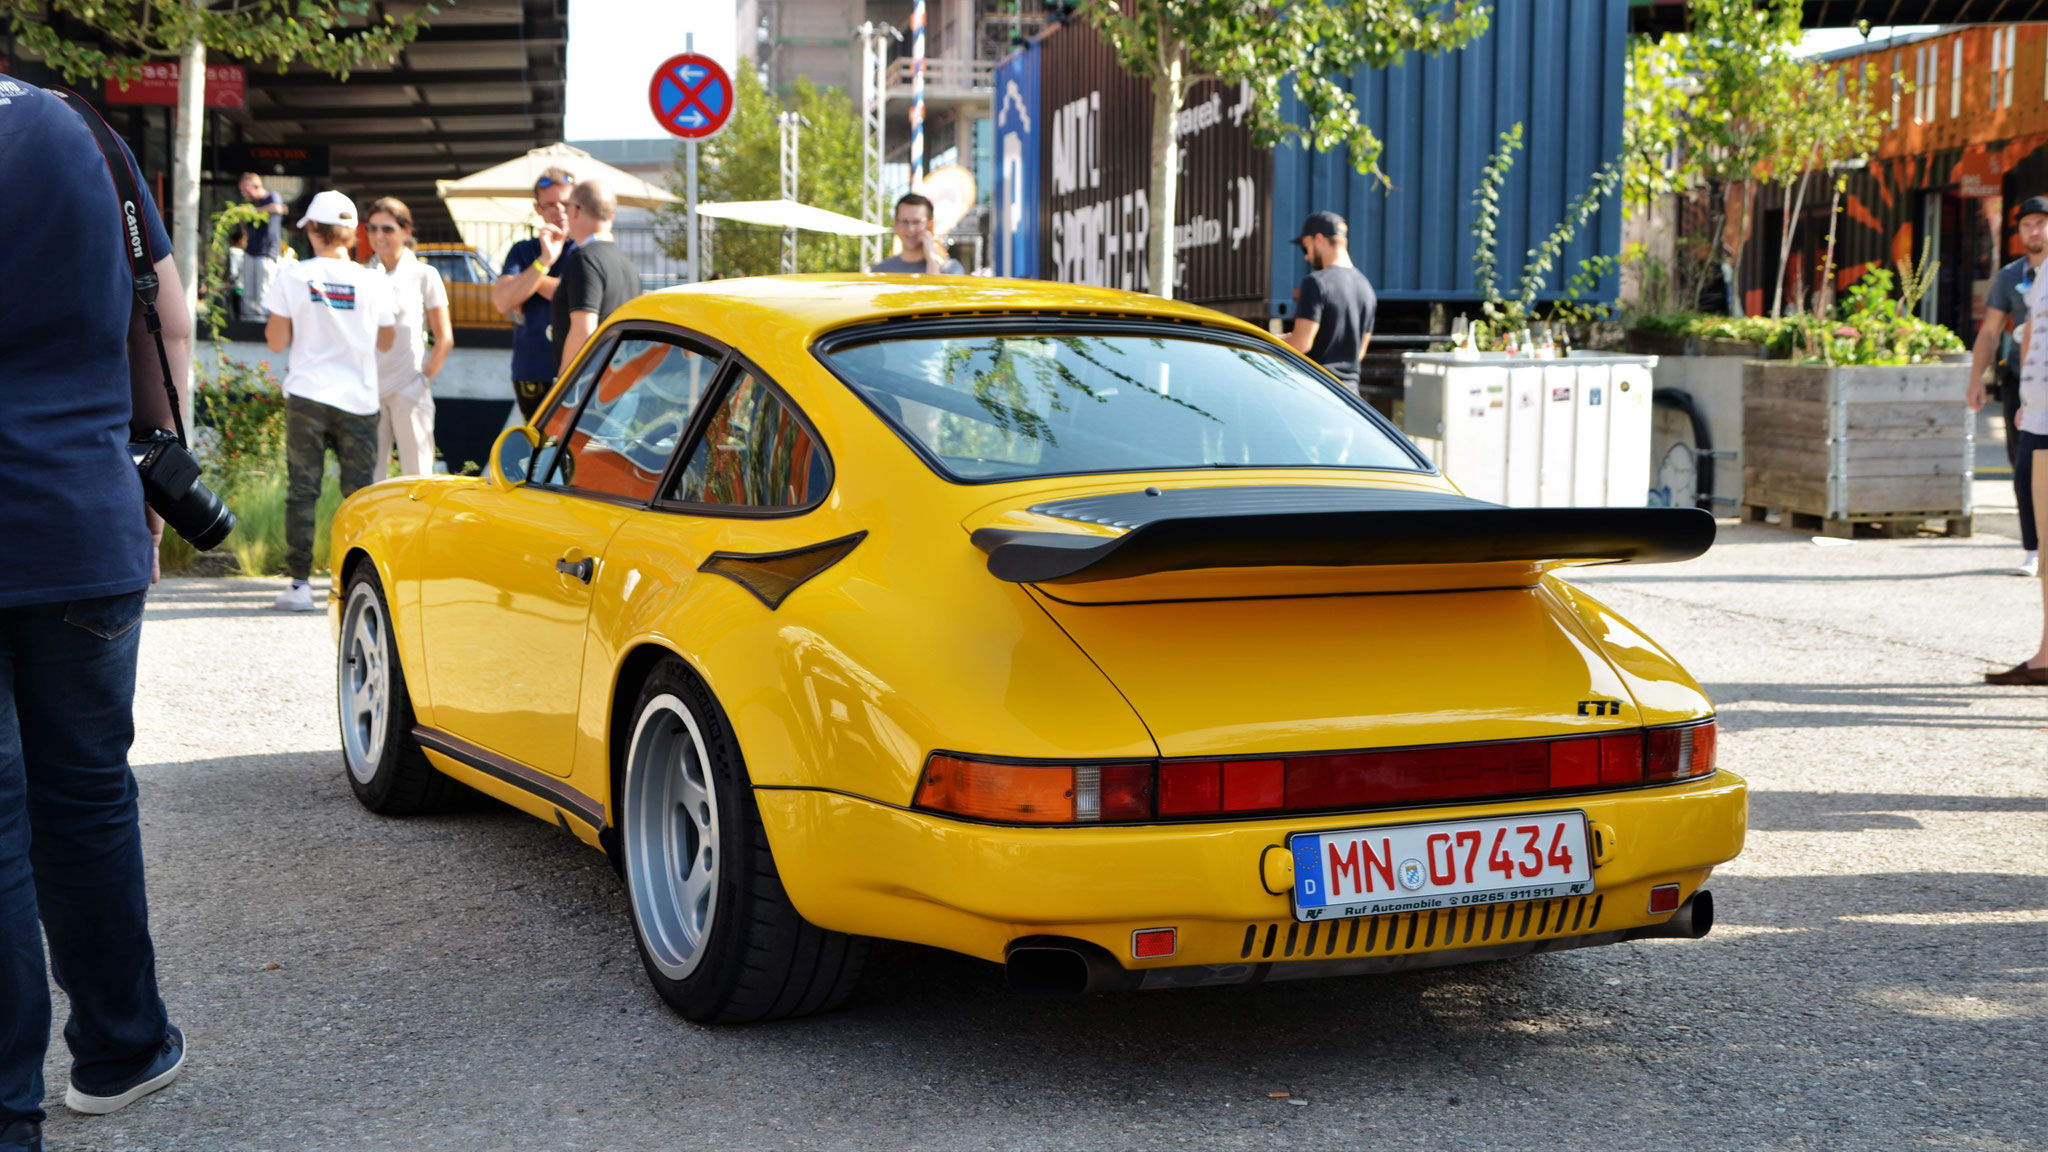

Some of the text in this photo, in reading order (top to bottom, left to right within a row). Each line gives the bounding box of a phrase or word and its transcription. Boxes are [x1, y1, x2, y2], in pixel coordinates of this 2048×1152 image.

[124, 200, 144, 258] Canon
[1328, 837, 1395, 896] MN
[1427, 822, 1574, 886] 07434
[1305, 878, 1317, 895] D
[1345, 905, 1368, 916] Ruf
[1371, 898, 1443, 914] Automobile
